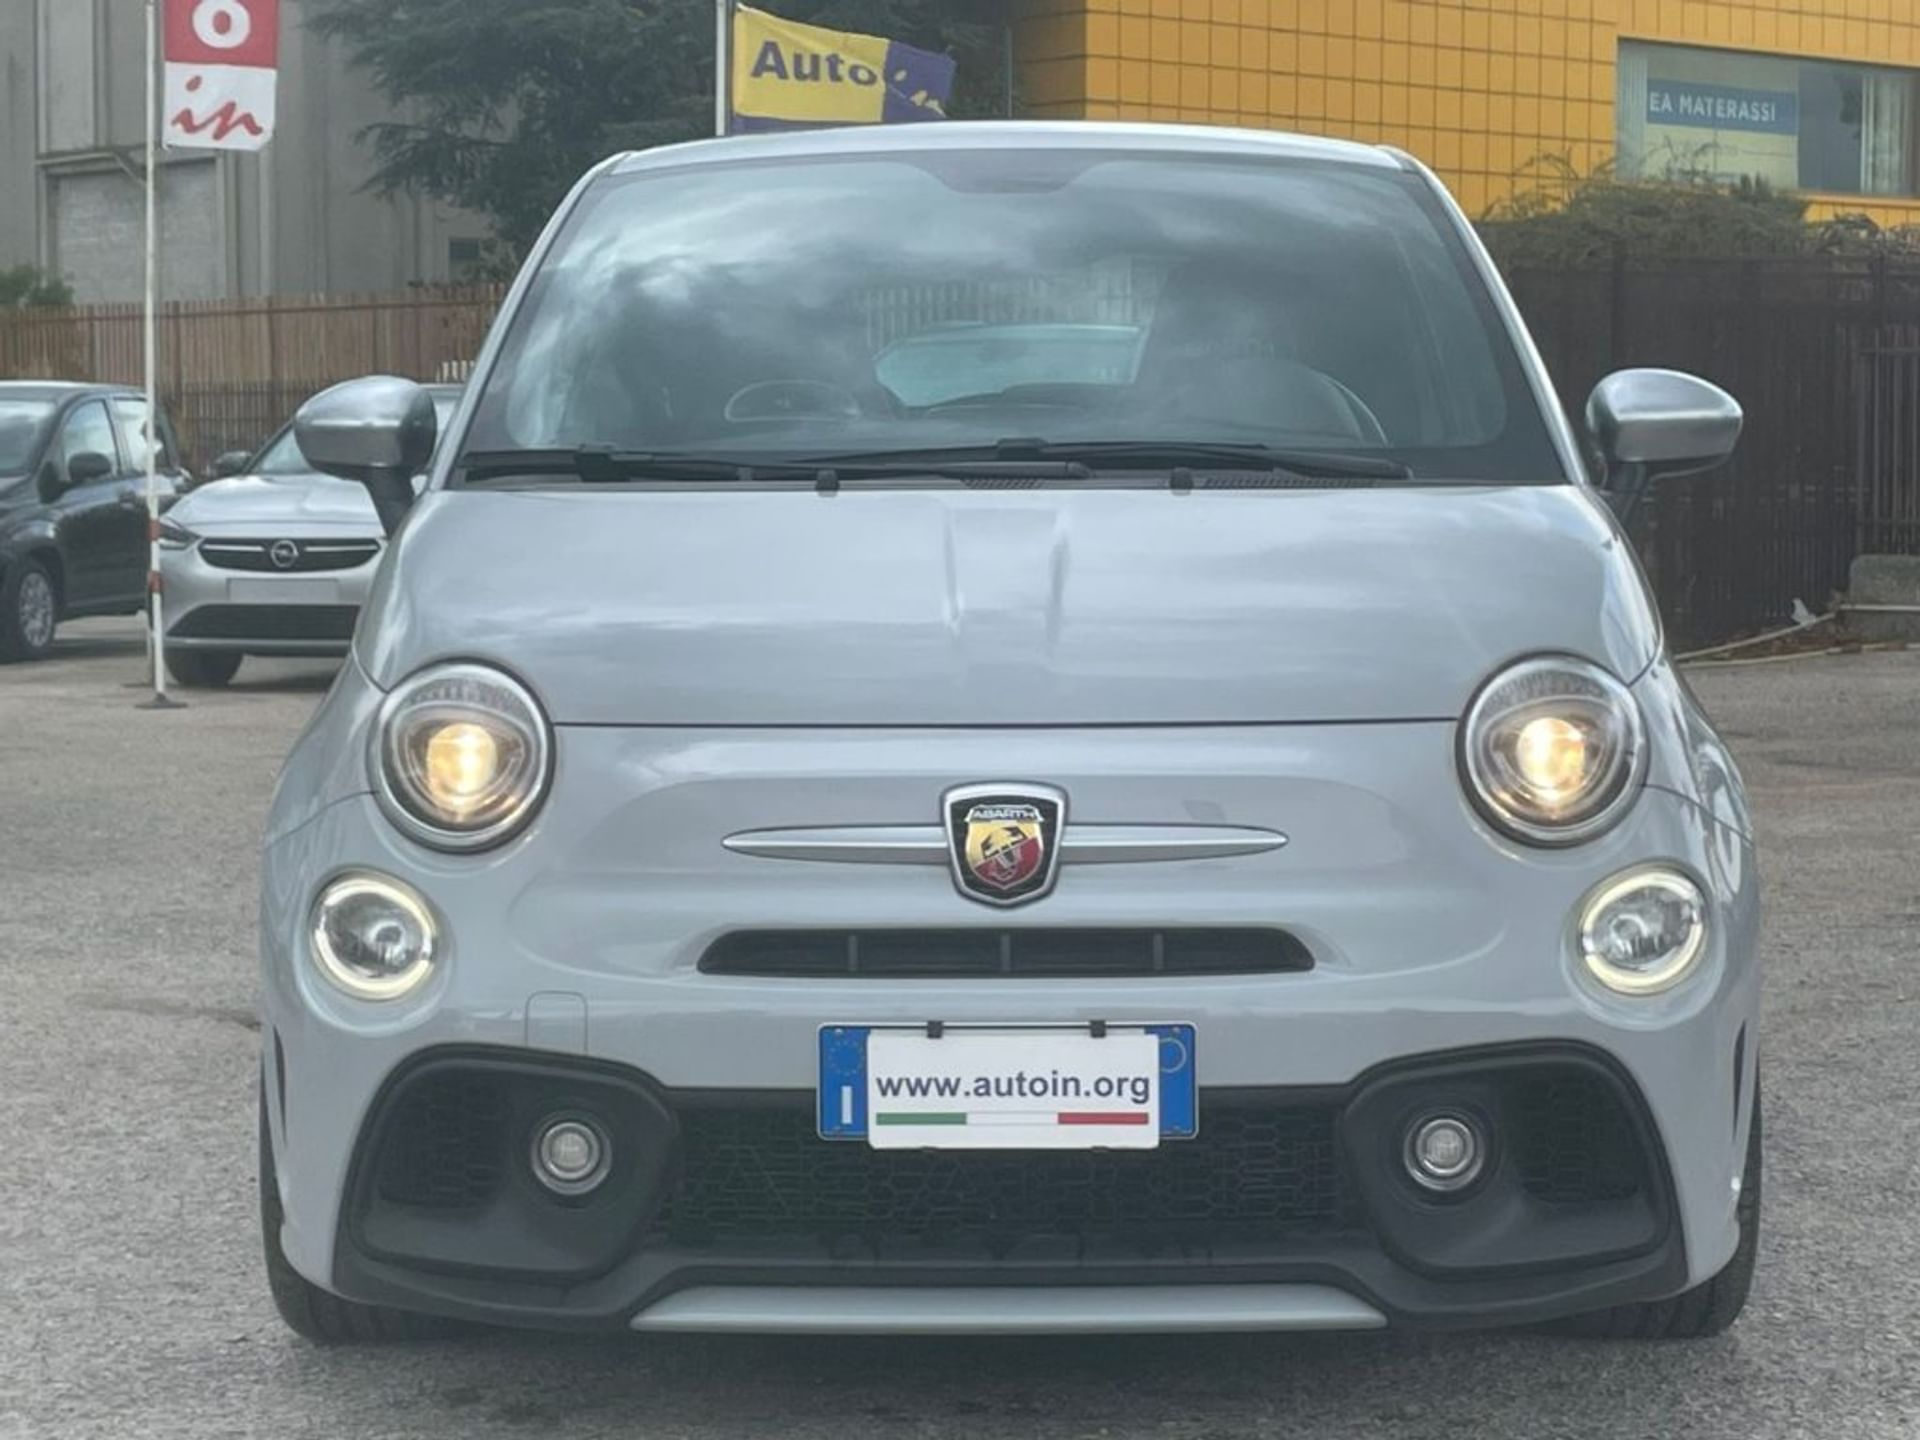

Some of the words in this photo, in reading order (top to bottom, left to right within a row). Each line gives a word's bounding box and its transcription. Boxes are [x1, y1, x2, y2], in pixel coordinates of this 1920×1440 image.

[751, 40, 878, 86] Auto
[171, 75, 263, 141] in
[1679, 93, 1776, 122] MATERASSI
[876, 1070, 1150, 1104] www.autoin.org
